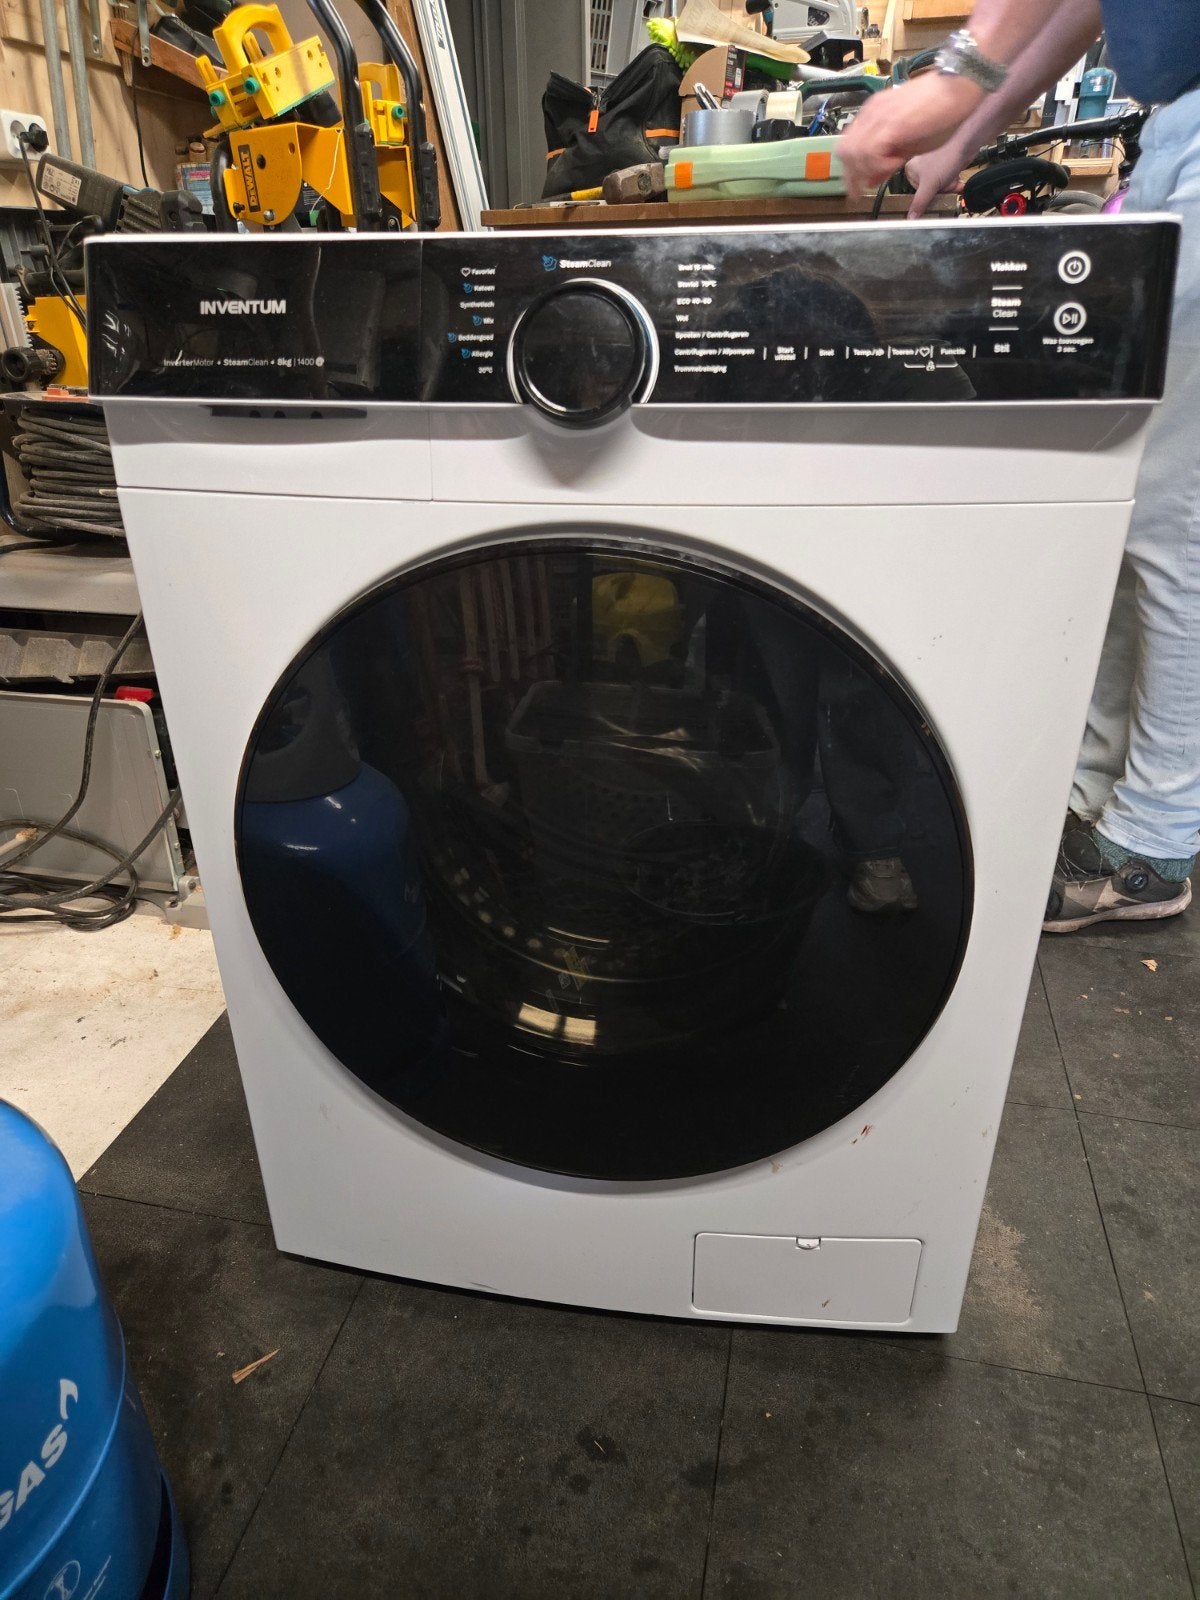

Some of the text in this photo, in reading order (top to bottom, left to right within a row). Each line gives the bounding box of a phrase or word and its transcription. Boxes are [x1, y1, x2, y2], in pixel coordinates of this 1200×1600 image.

[240, 151, 259, 206] DEWALT
[559, 259, 612, 269] SteamClean
[990, 261, 1028, 272] Vlekken
[676, 297, 691, 305] ECO
[991, 297, 1022, 307] Steam
[200, 299, 287, 315] INVENTUM
[992, 308, 1018, 318] Clean
[940, 347, 967, 355] Functie
[993, 342, 1011, 353] Stil
[163, 357, 315, 368] InverterMotor SteamClean 8kg 1400
